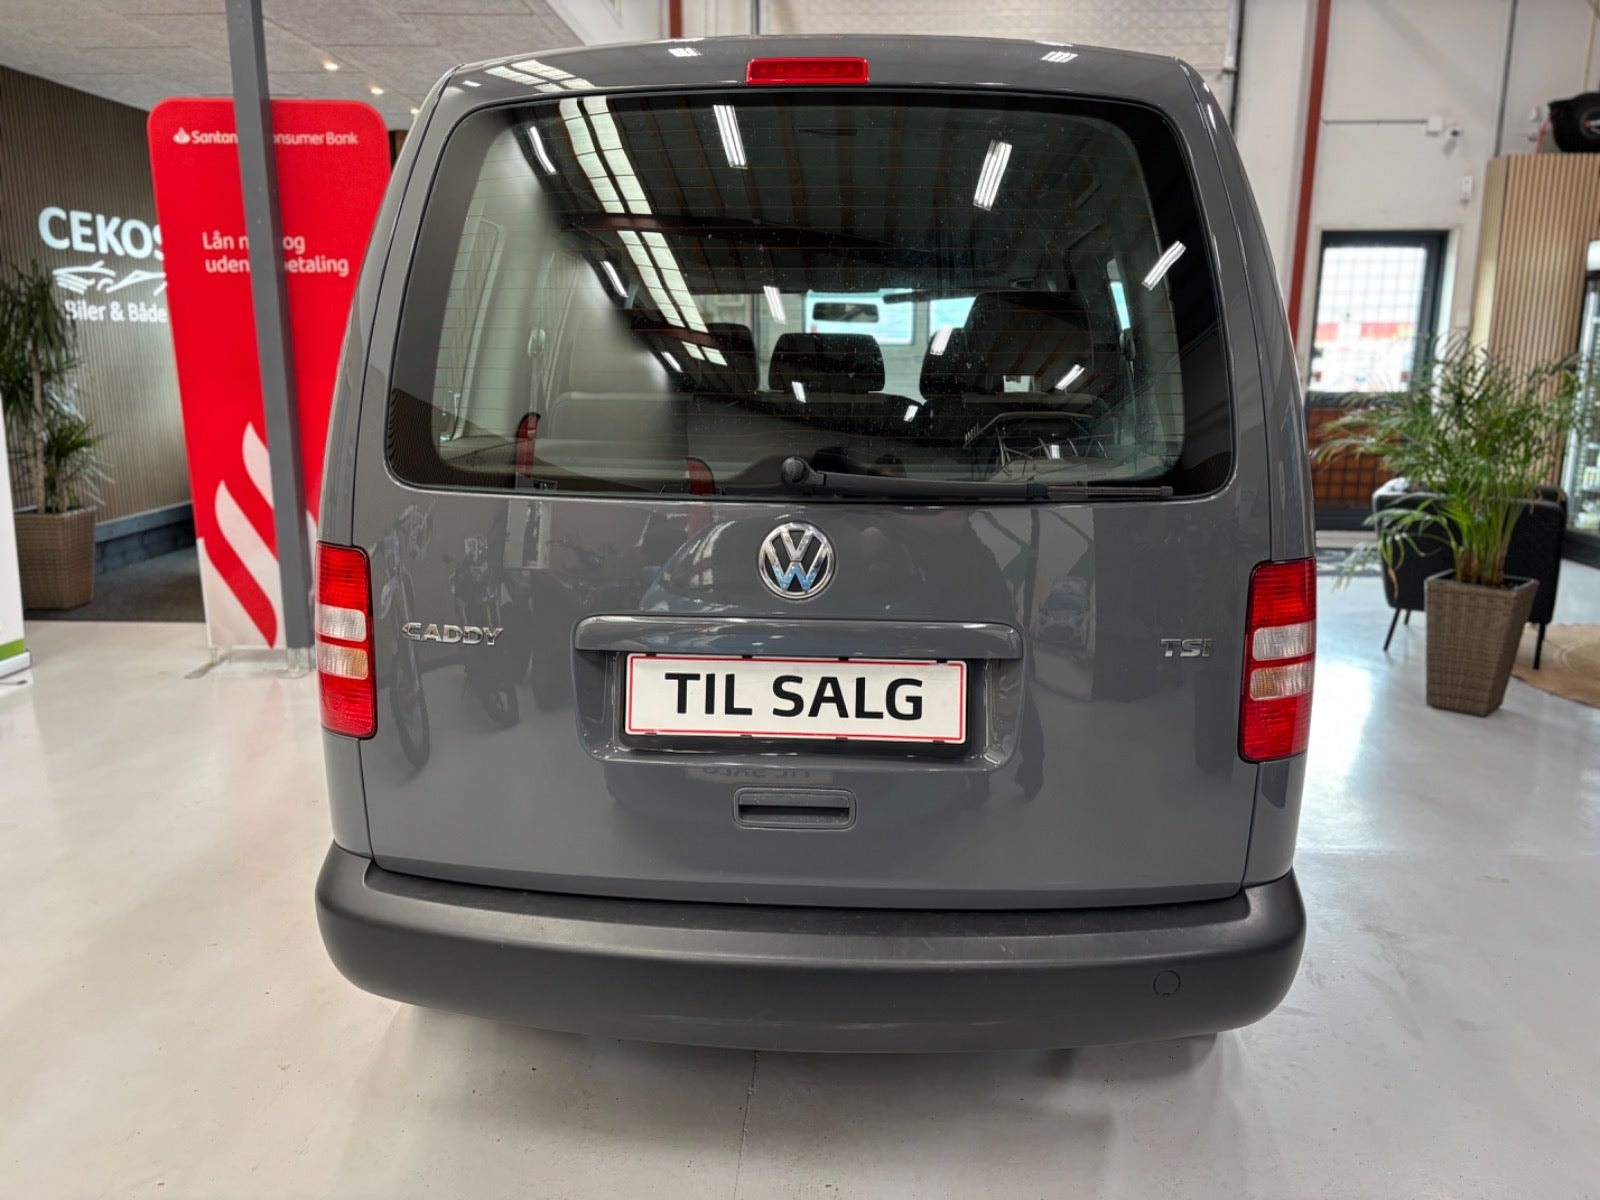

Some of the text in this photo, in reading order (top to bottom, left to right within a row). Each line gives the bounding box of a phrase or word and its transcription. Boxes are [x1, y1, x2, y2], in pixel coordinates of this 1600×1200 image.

[191, 130, 359, 146] Santan nsumer Bank
[202, 230, 235, 250] Lån
[282, 236, 306, 255] og
[205, 255, 349, 278] uden etaling
[64, 299, 106, 321] Biler
[109, 301, 125, 322] &
[402, 622, 503, 646] CADDY
[1160, 638, 1212, 657] TSI
[665, 672, 923, 721] TIL SALG
